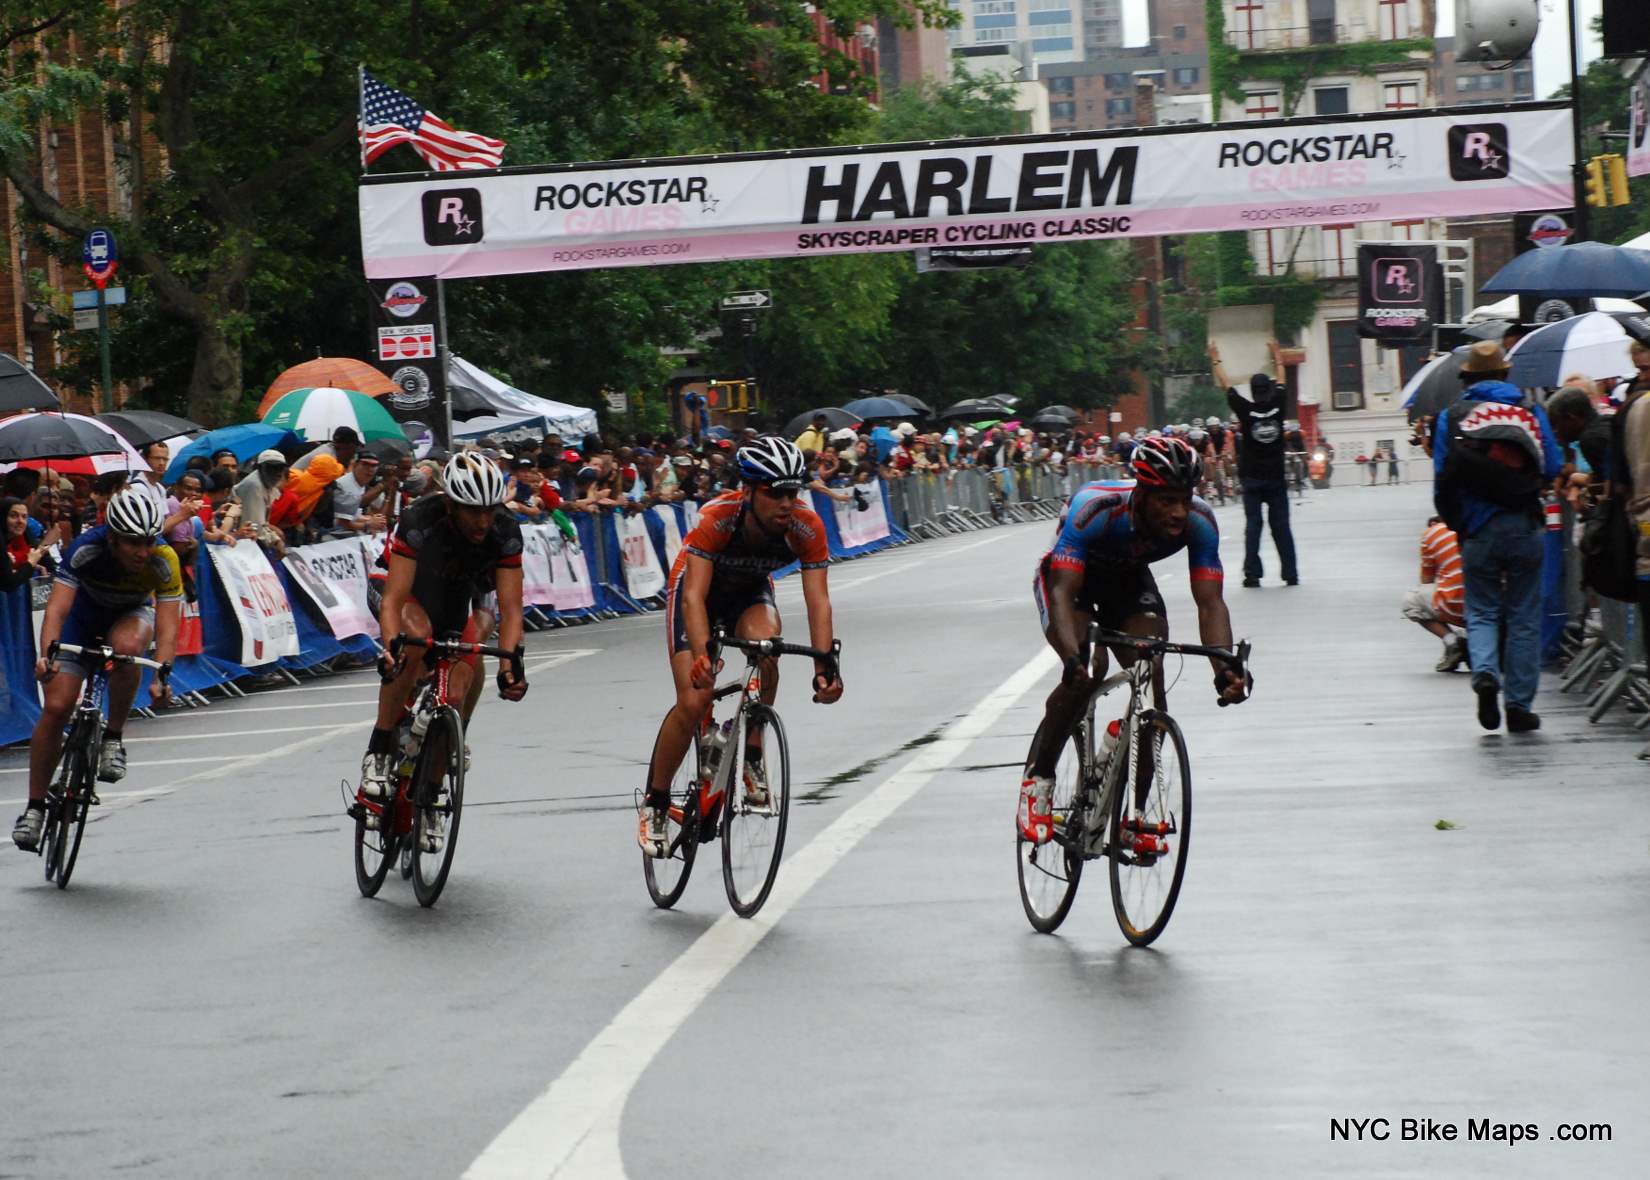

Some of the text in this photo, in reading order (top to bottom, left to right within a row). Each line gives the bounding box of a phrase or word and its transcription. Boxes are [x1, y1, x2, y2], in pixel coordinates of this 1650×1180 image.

[1218, 132, 1393, 169] ROCKSTAR
[801, 146, 1139, 224] HARLEM
[1248, 161, 1367, 192] GAMES
[534, 176, 708, 211] ROCKSTAR
[564, 204, 682, 236] GAMES
[1240, 202, 1380, 221] ROCKSTARGAMES.COM
[798, 216, 1132, 249] SKYSCRAPER CYCLING CLASSIC
[553, 243, 691, 263] ROCKSTARGAMES.COM
[381, 335, 432, 358] DOT
